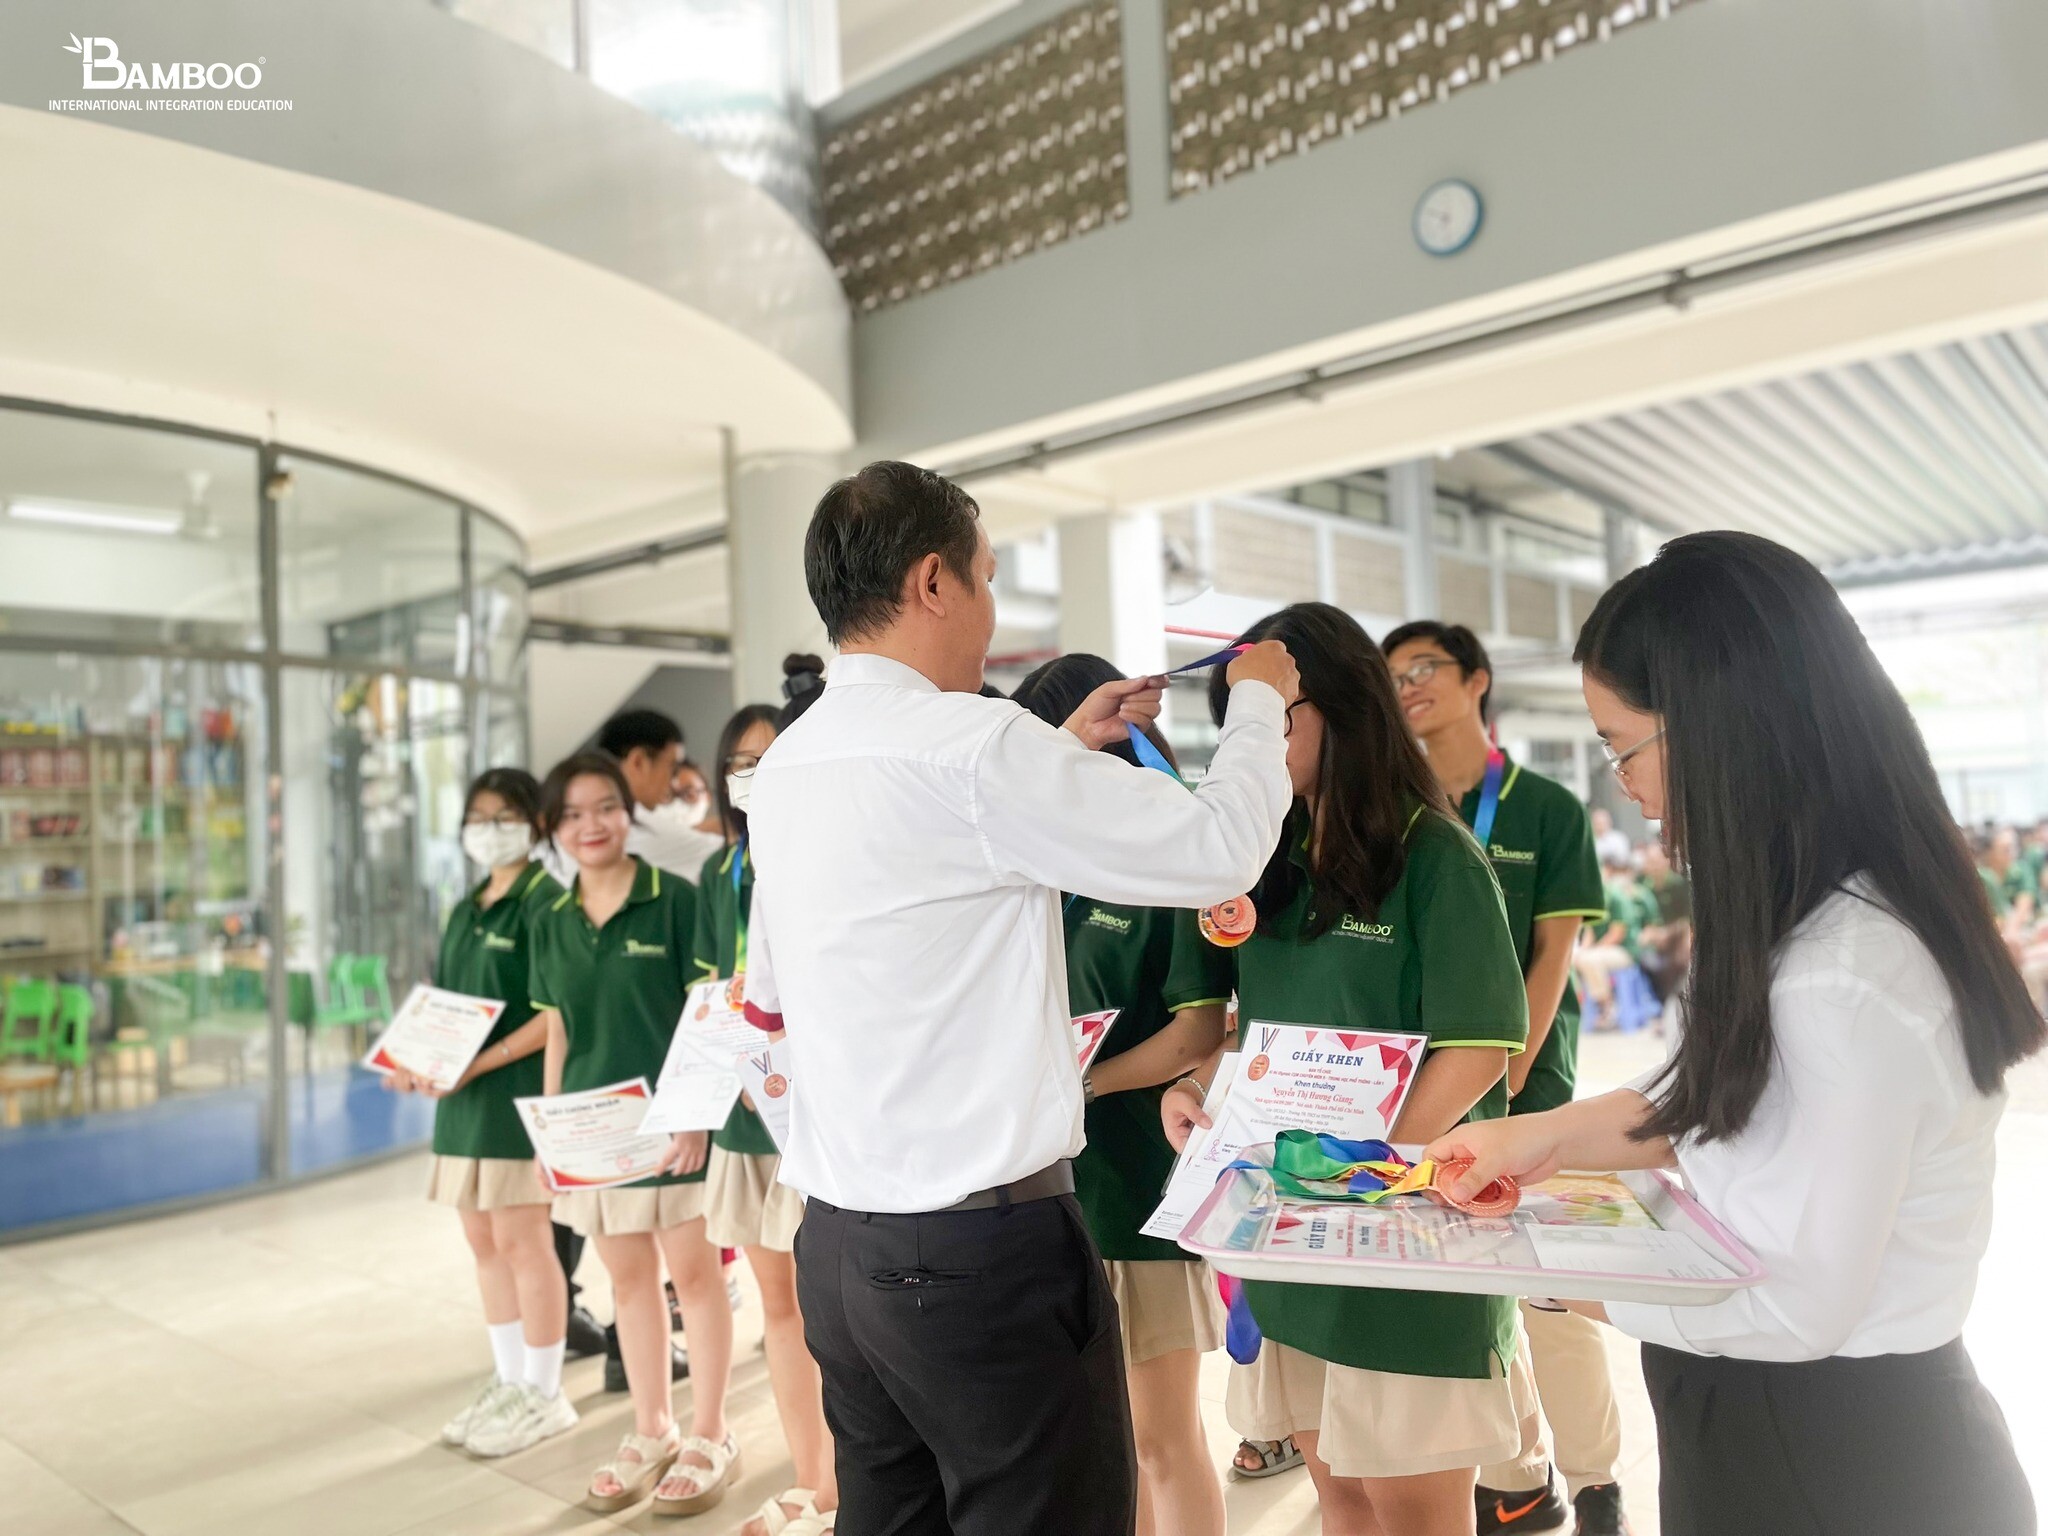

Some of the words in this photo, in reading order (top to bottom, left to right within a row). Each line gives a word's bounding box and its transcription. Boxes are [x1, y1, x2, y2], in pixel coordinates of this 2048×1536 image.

[1341, 913, 1391, 936] BAMBOO
[1292, 1048, 1323, 1063] GIẤY
[1326, 1054, 1364, 1066] KHEN
[1294, 1080, 1311, 1088] Khen
[1312, 1081, 1336, 1091] thưởng
[1297, 1089, 1308, 1099] Thị
[1333, 1094, 1354, 1105] Giang
